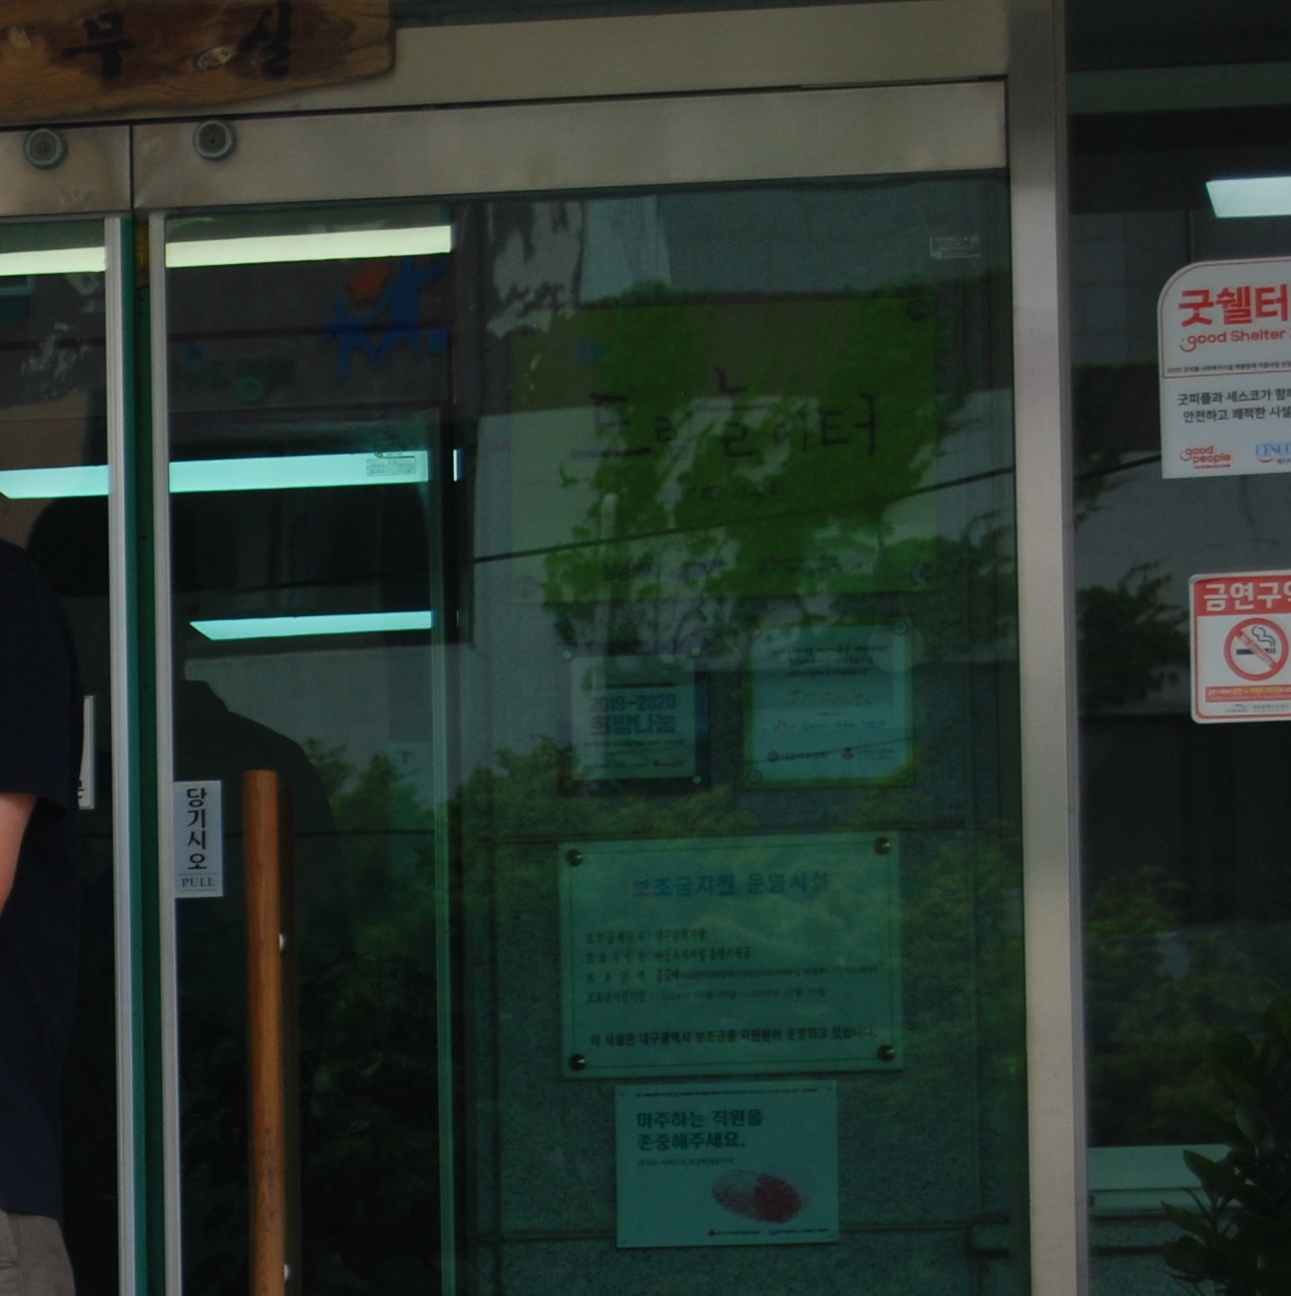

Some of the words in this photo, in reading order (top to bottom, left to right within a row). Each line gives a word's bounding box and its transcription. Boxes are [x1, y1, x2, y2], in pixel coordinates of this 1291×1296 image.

[1178, 284, 1289, 328] 굿쉘터
[1231, 328, 1286, 342] Shelter
[1178, 391, 1223, 407] 굿피플과
[1226, 388, 1271, 402] 세스코가
[1183, 409, 1229, 424] 안전하고
[1232, 406, 1266, 420] 쾌적한
[187, 788, 207, 870] 당기시오
[182, 877, 215, 887] PULL
[633, 874, 735, 898] 보조금지원
[636, 1110, 705, 1129] 마주하는
[712, 1108, 762, 1127] 직원을
[638, 1131, 746, 1151] 존중해주세요.
